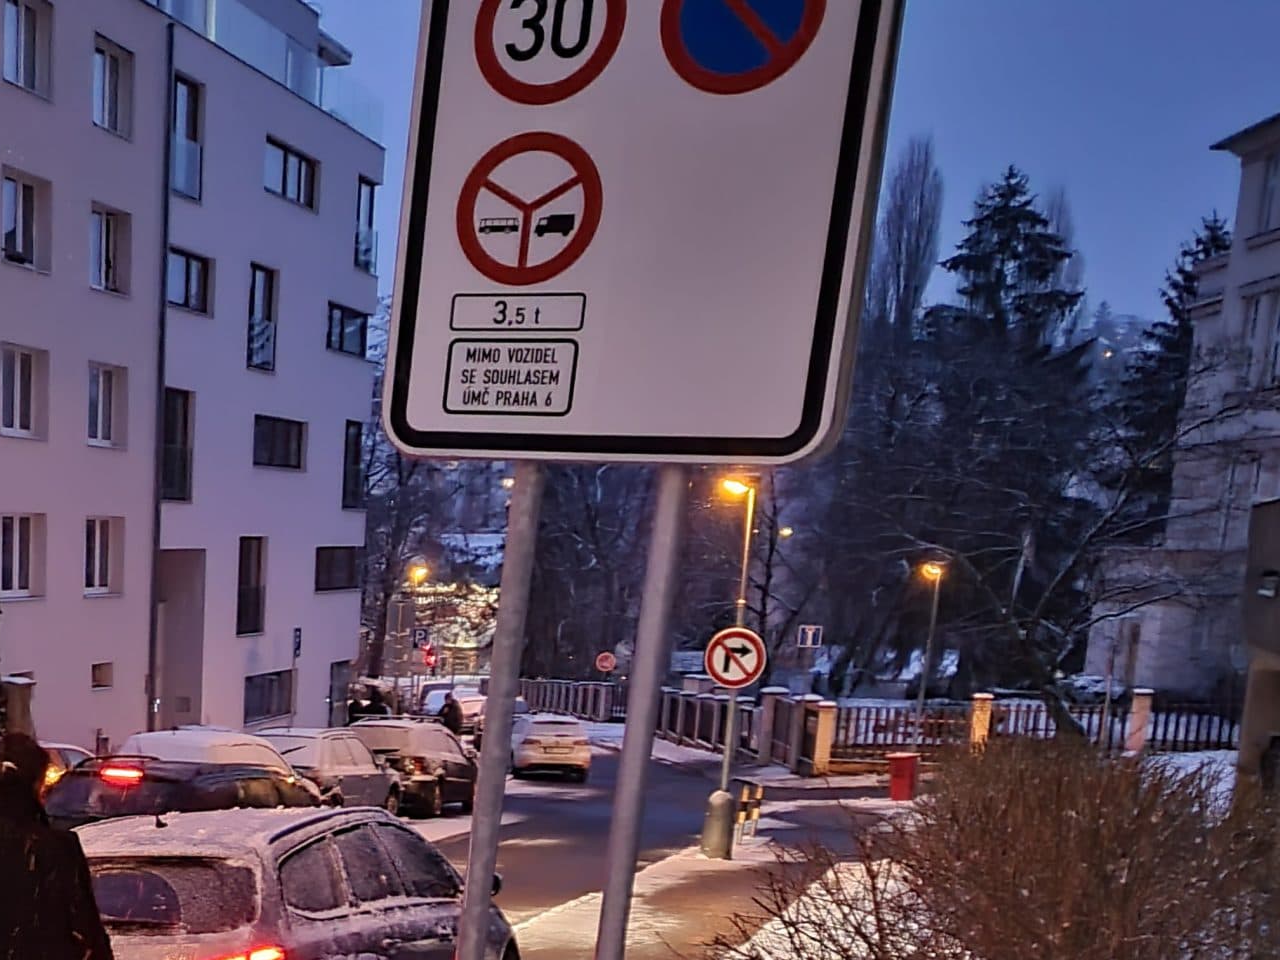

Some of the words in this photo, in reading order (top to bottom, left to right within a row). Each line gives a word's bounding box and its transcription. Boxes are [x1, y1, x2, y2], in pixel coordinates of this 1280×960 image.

[505, 0, 594, 62] 30
[493, 300, 526, 326] 3,5
[534, 307, 541, 325] t
[465, 347, 501, 363] MIMO
[507, 348, 558, 364] VOZIDEL
[461, 369, 477, 384] SE
[483, 369, 560, 385] SOUHLASEM
[462, 386, 489, 406] ÚMČ
[495, 390, 538, 407] PRAHA
[544, 391, 553, 407] 6
